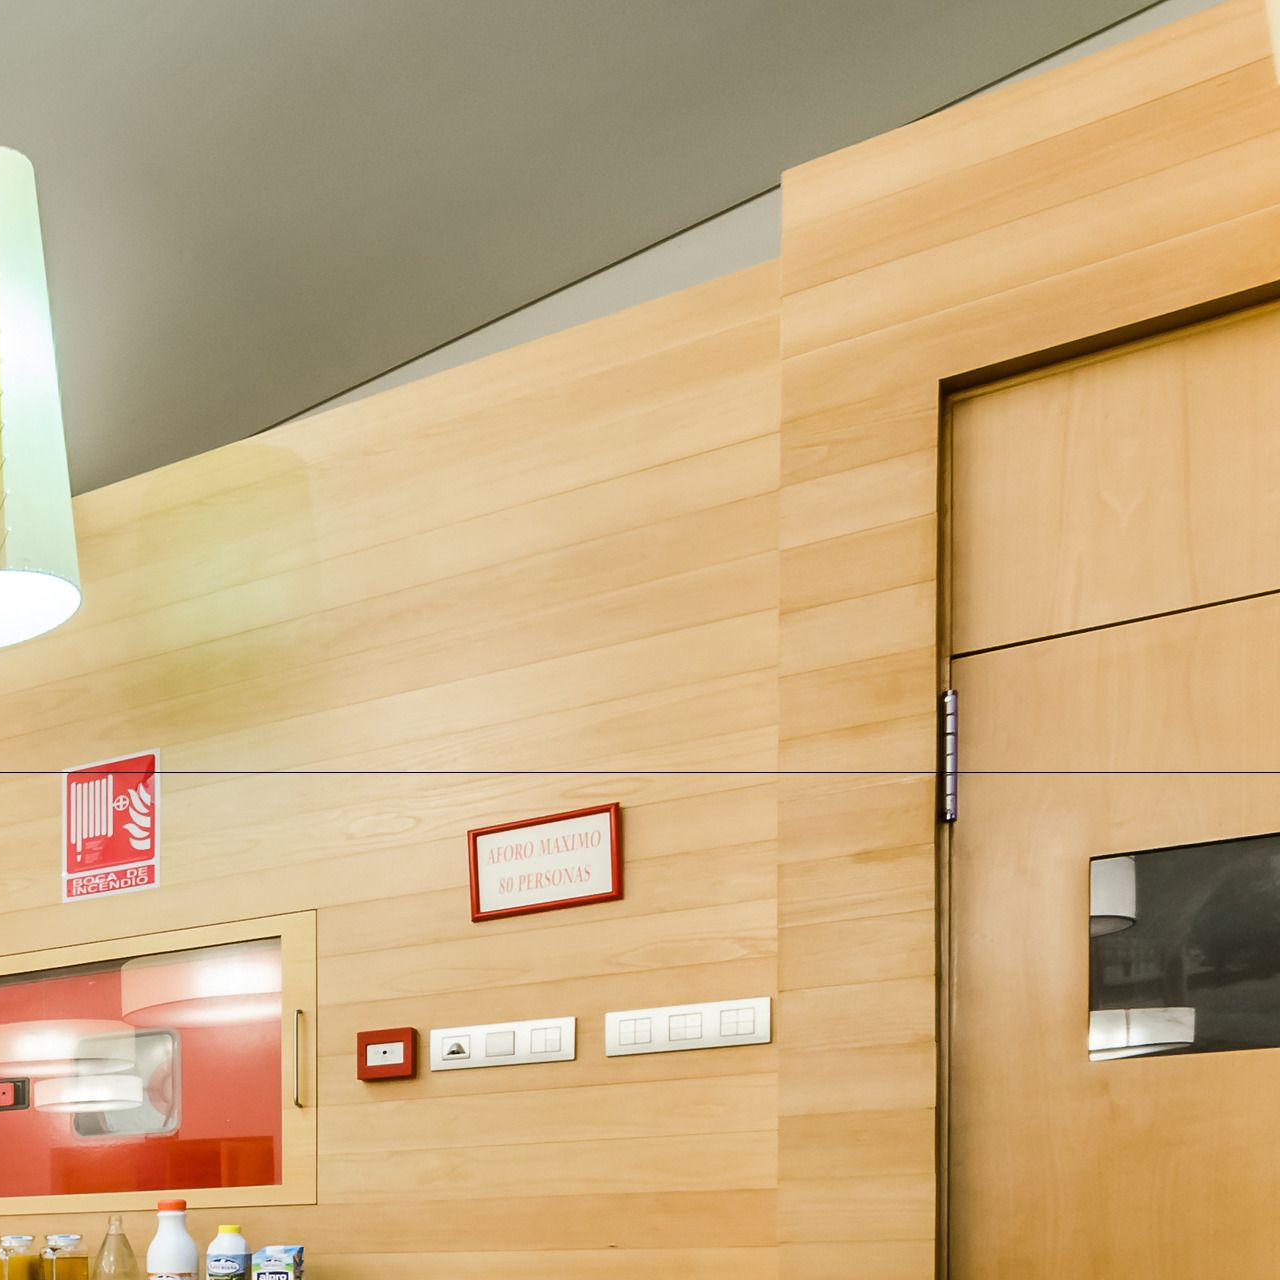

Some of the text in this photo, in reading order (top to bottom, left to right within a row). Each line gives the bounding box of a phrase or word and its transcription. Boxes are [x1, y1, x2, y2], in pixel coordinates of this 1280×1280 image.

[487, 829, 602, 865] AFORO MAXIMO
[126, 866, 149, 878] DE
[498, 863, 592, 895] 80 PERSONAS
[72, 875, 149, 896] INCENDIO
